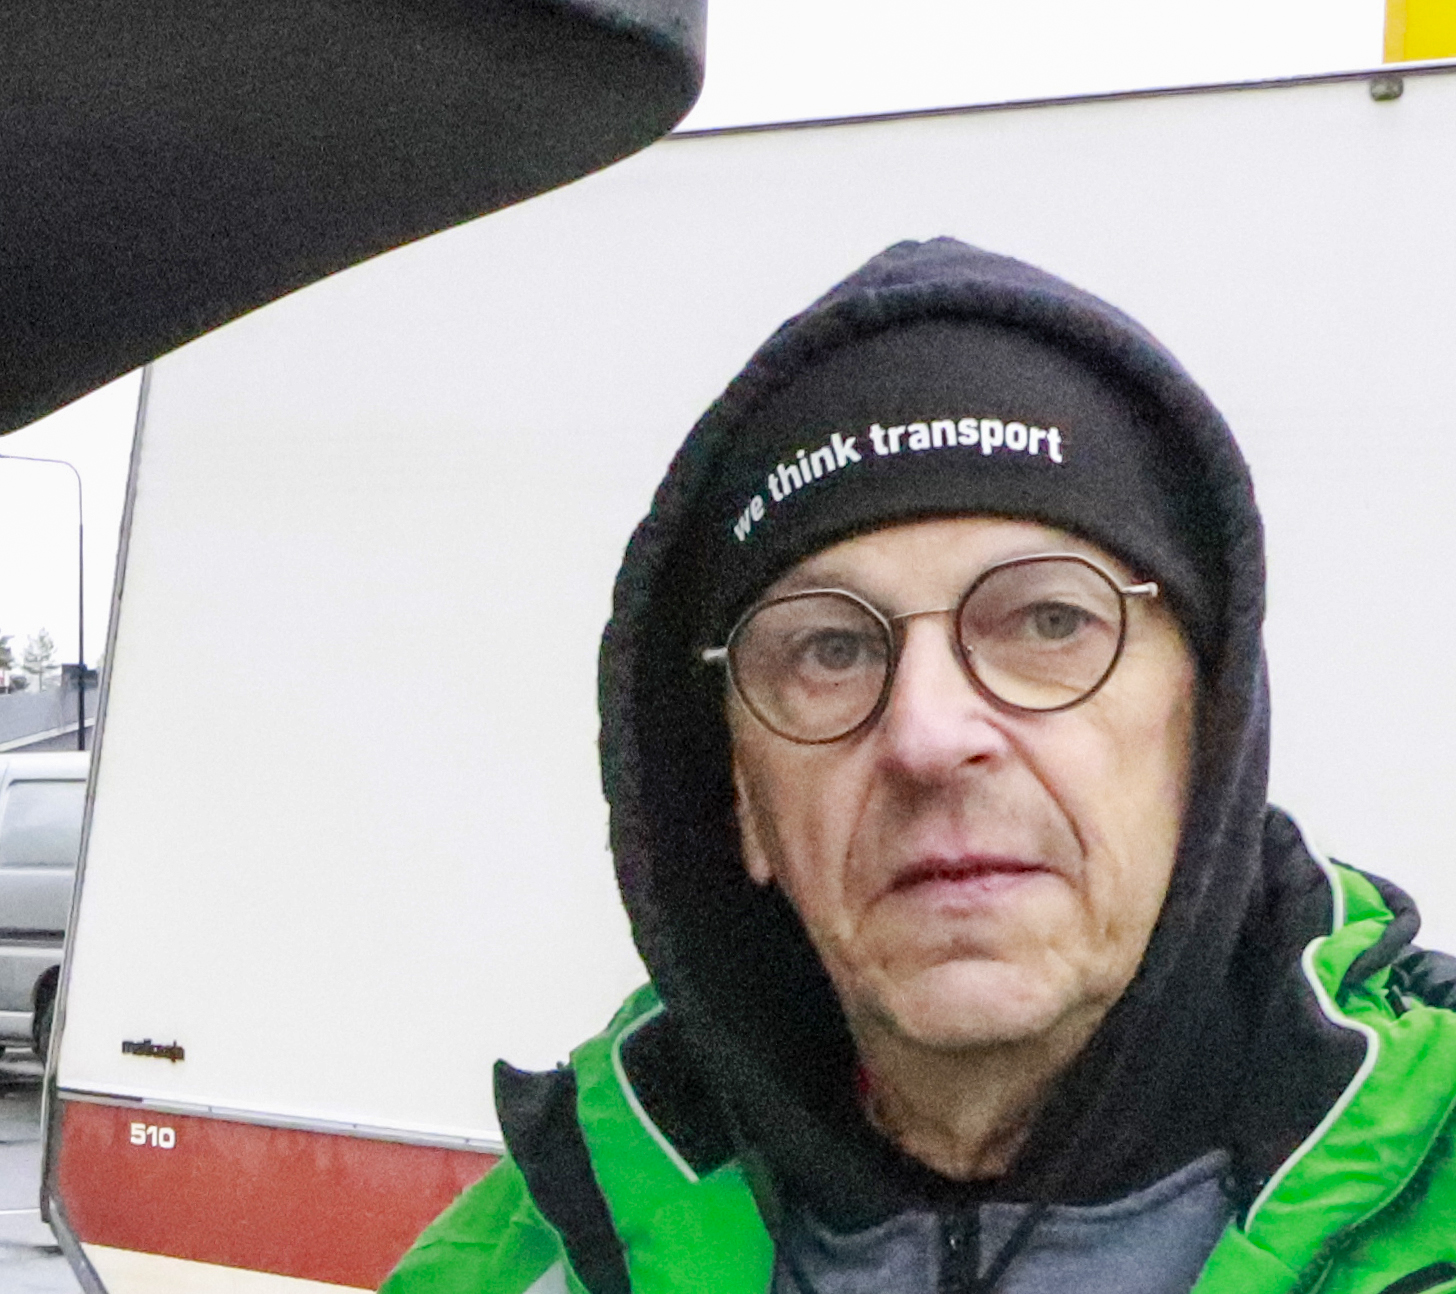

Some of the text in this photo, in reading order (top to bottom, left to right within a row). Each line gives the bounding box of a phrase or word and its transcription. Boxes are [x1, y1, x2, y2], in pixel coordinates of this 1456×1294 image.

[732, 415, 1065, 542] we think transport
[129, 1121, 176, 1149] 510
